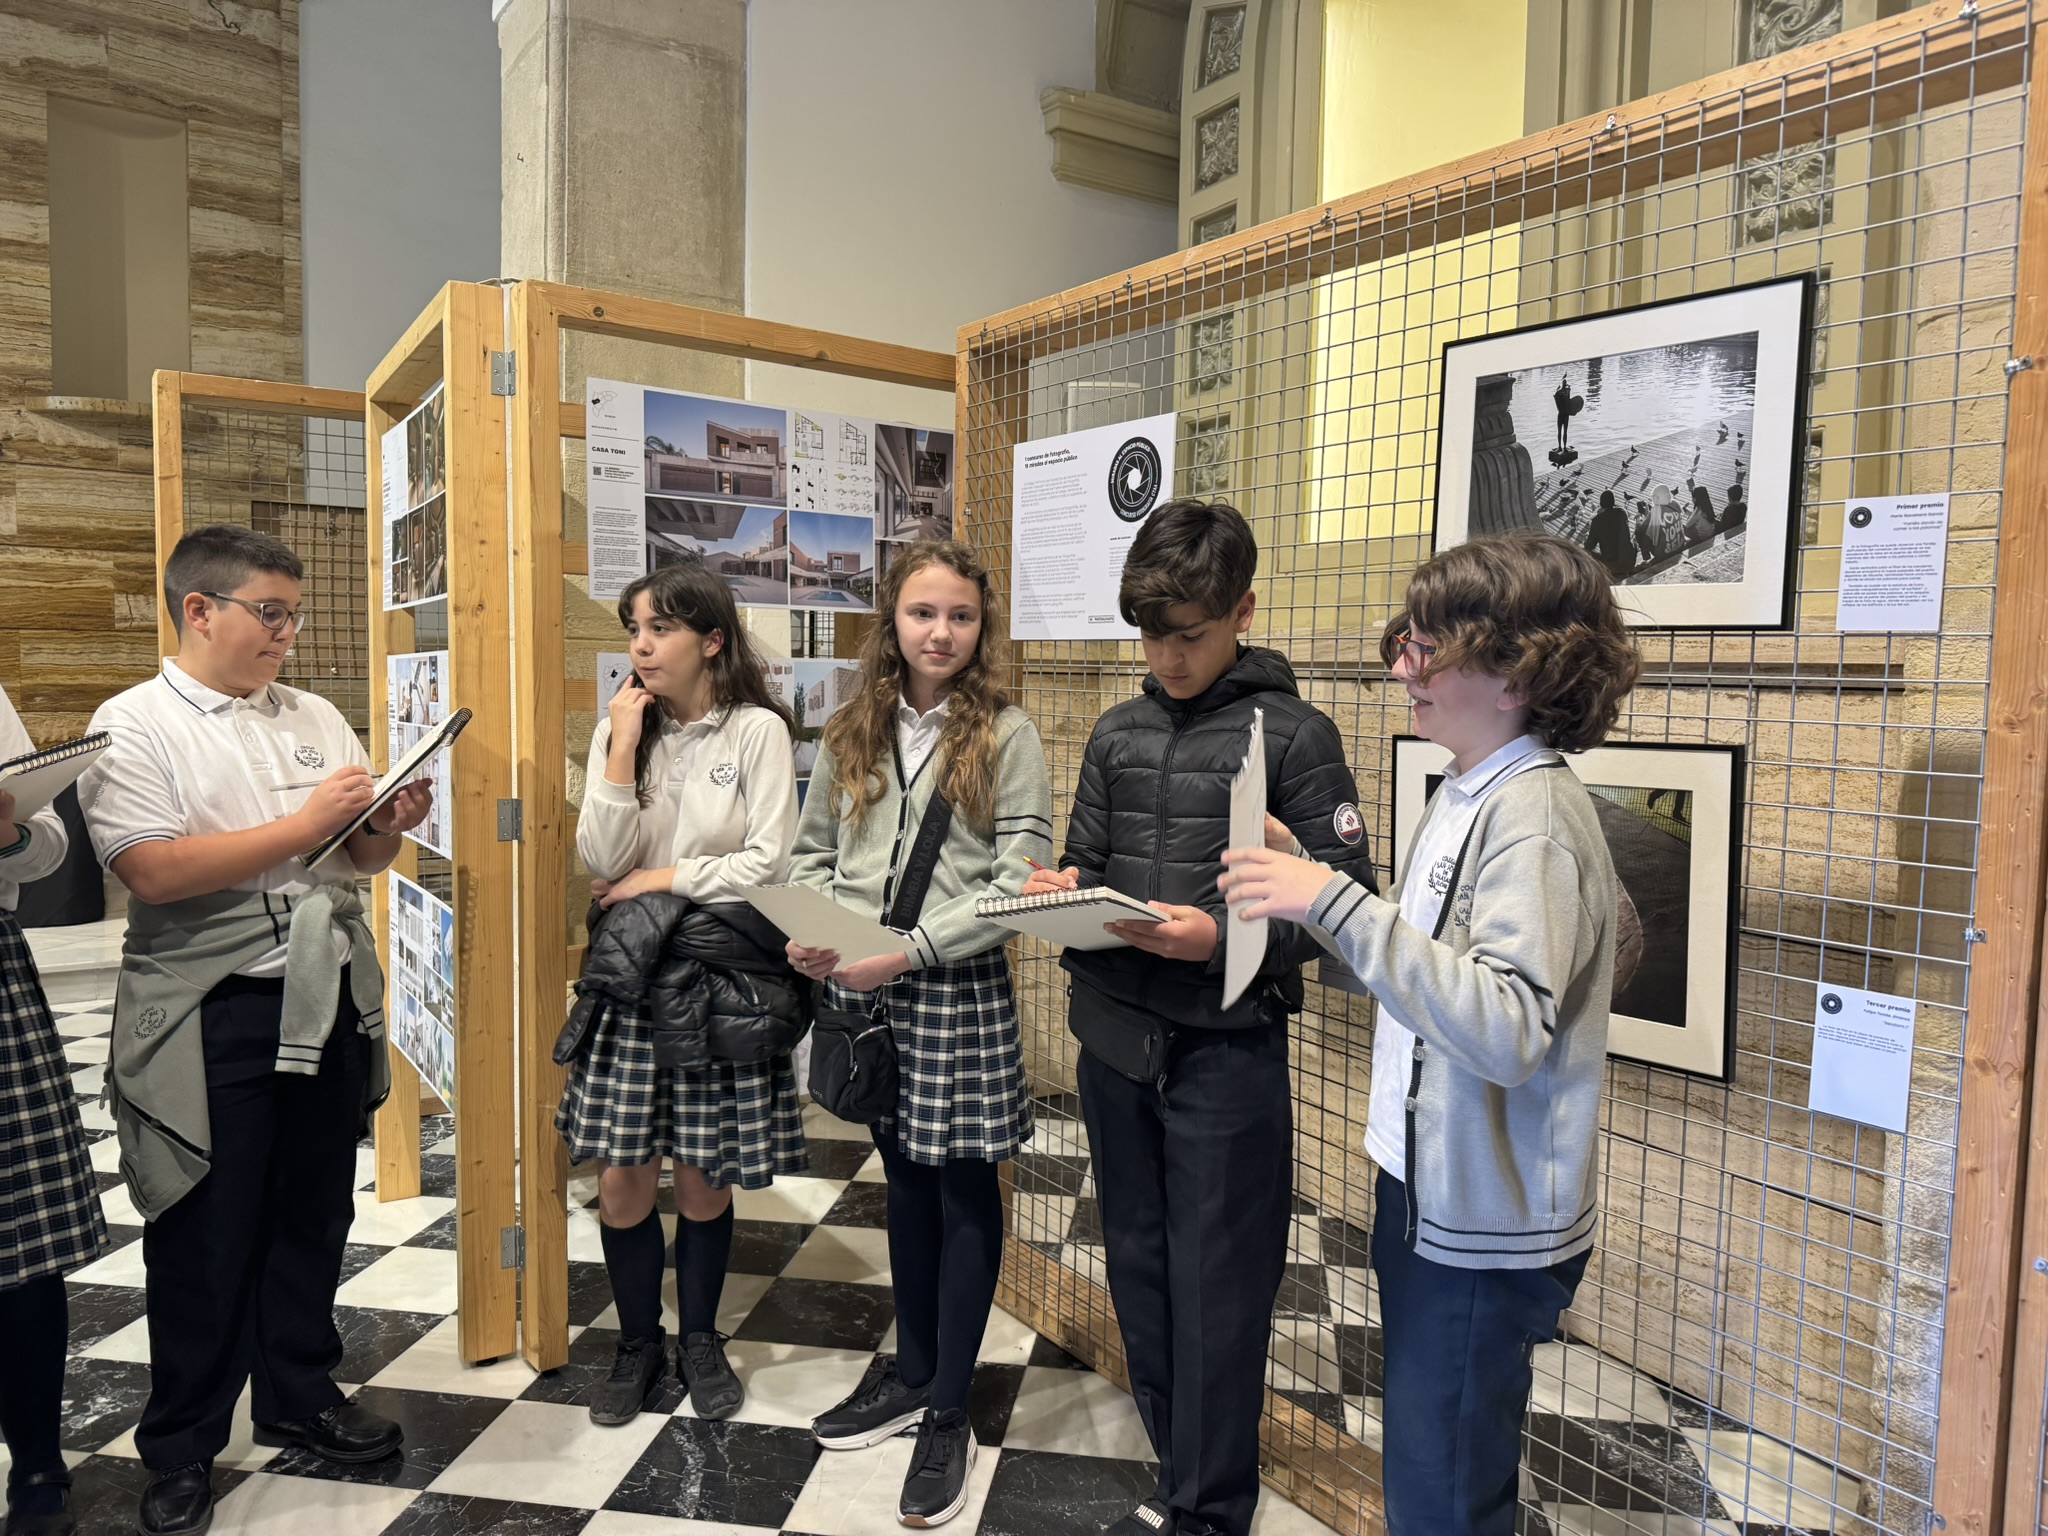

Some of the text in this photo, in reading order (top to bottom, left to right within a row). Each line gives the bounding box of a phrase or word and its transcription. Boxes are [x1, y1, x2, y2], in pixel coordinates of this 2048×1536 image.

[1920, 502, 1944, 510] premio
[1866, 1000, 1911, 1013] Tercer premio
[1134, 1504, 1165, 1529] PUMA
